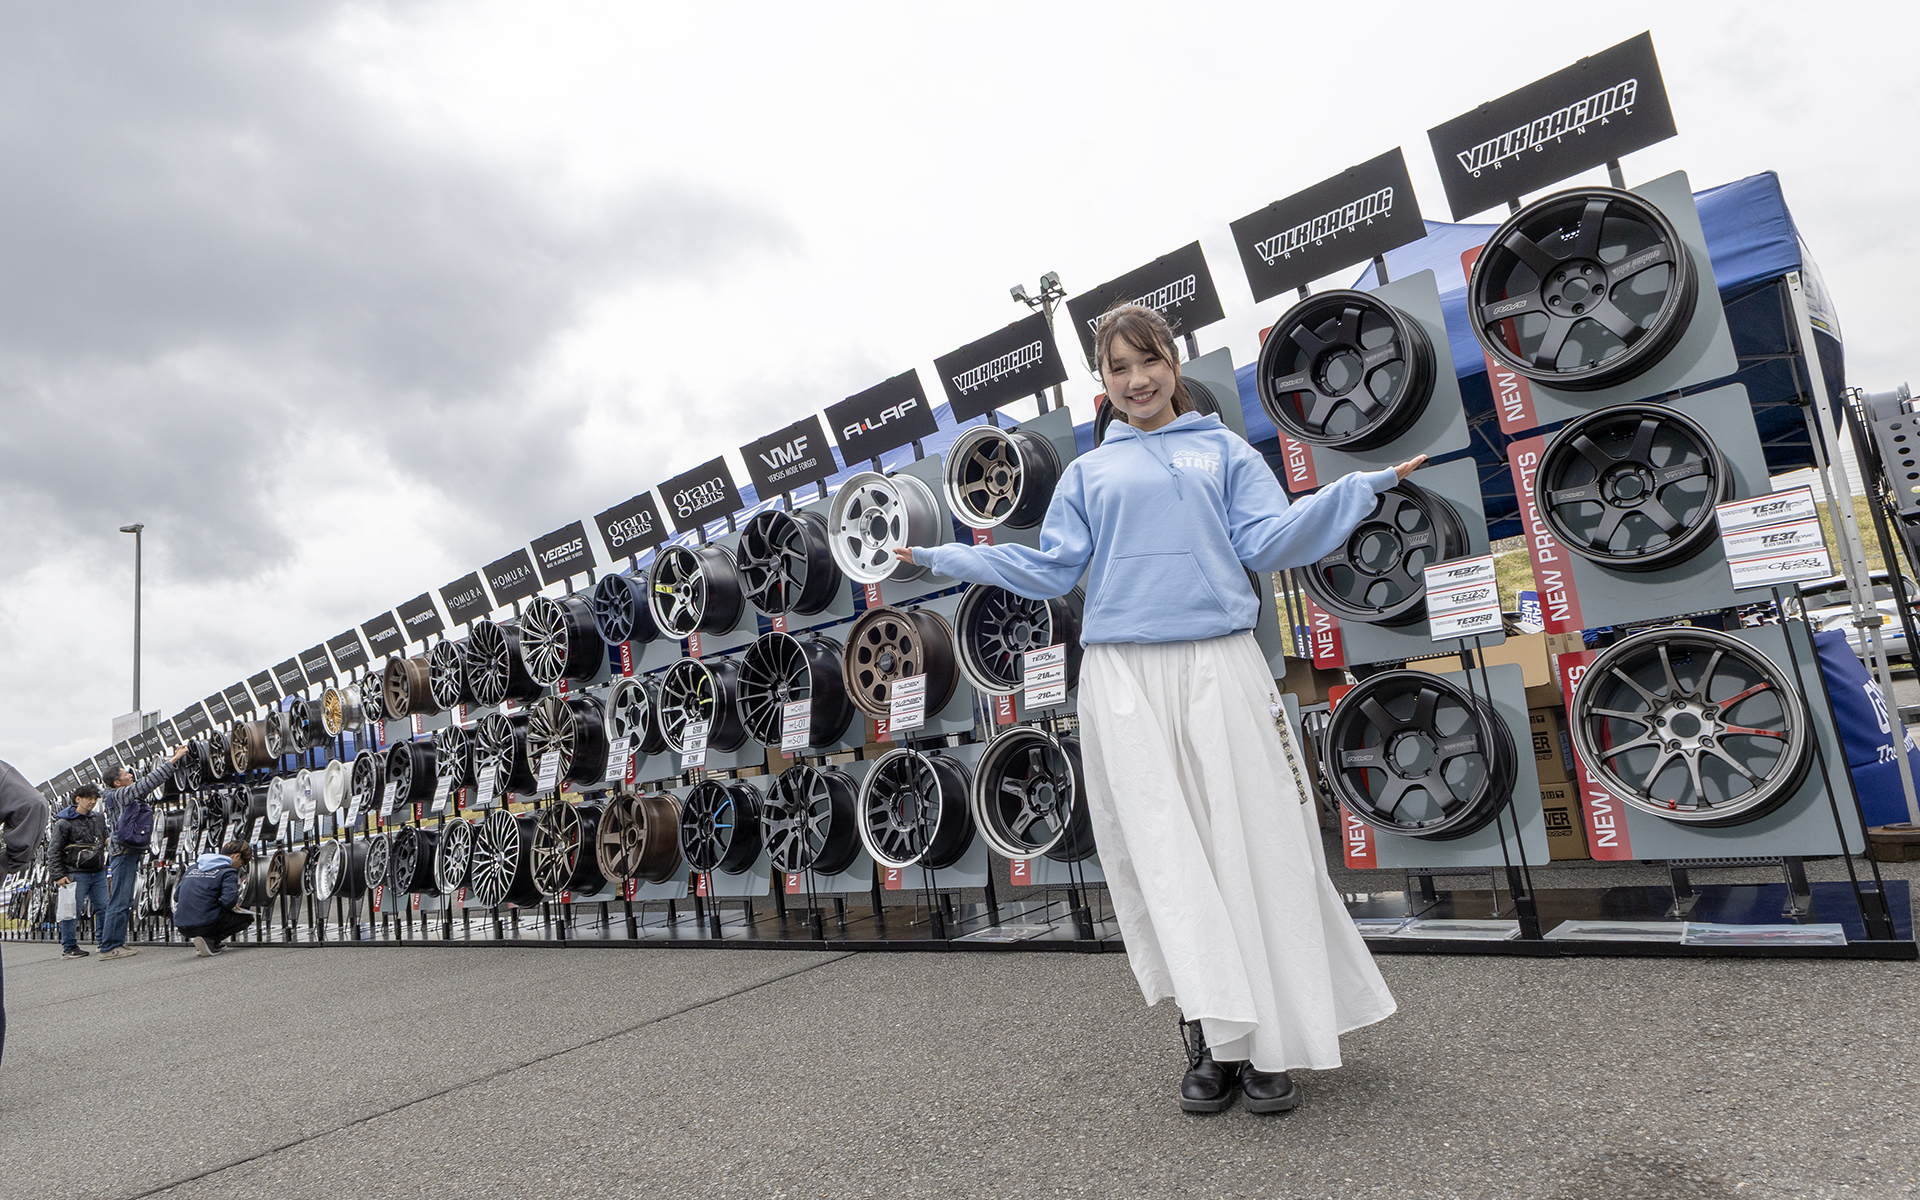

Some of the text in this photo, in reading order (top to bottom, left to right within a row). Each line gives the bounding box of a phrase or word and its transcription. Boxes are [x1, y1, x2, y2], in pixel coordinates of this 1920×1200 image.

[1456, 78, 1637, 173] VOLK RACING
[1473, 107, 1632, 178] ORIGINAL
[1254, 186, 1393, 261] VOLK RACING
[1268, 211, 1391, 266] ORIGINAL
[1494, 300, 1527, 315] RAYS
[951, 340, 1042, 391] VOLK RACING
[962, 358, 1042, 396] ORIGINAL
[1497, 372, 1525, 423] NEW
[758, 435, 808, 470] VMF
[1172, 450, 1220, 460] RAYS
[1172, 456, 1219, 475] STAFF
[1286, 438, 1308, 482] NEW
[767, 457, 817, 483] VERSUS MODE FORGED
[673, 476, 725, 518] gram
[1751, 500, 1788, 515] TE37
[608, 510, 652, 547] gram
[1761, 530, 1798, 544] TE37
[539, 537, 583, 563] VERSUS
[491, 564, 531, 589] HOMURA
[1447, 565, 1480, 578] TE37
[447, 587, 482, 609] HOMURA
[866, 583, 878, 602] NE
[1542, 570, 1571, 622] NEW
[690, 634, 698, 652] NE
[1315, 611, 1335, 660] NEW
[621, 645, 631, 672] NEW
[998, 694, 1011, 716] NE
[1589, 790, 1618, 848] NEW
